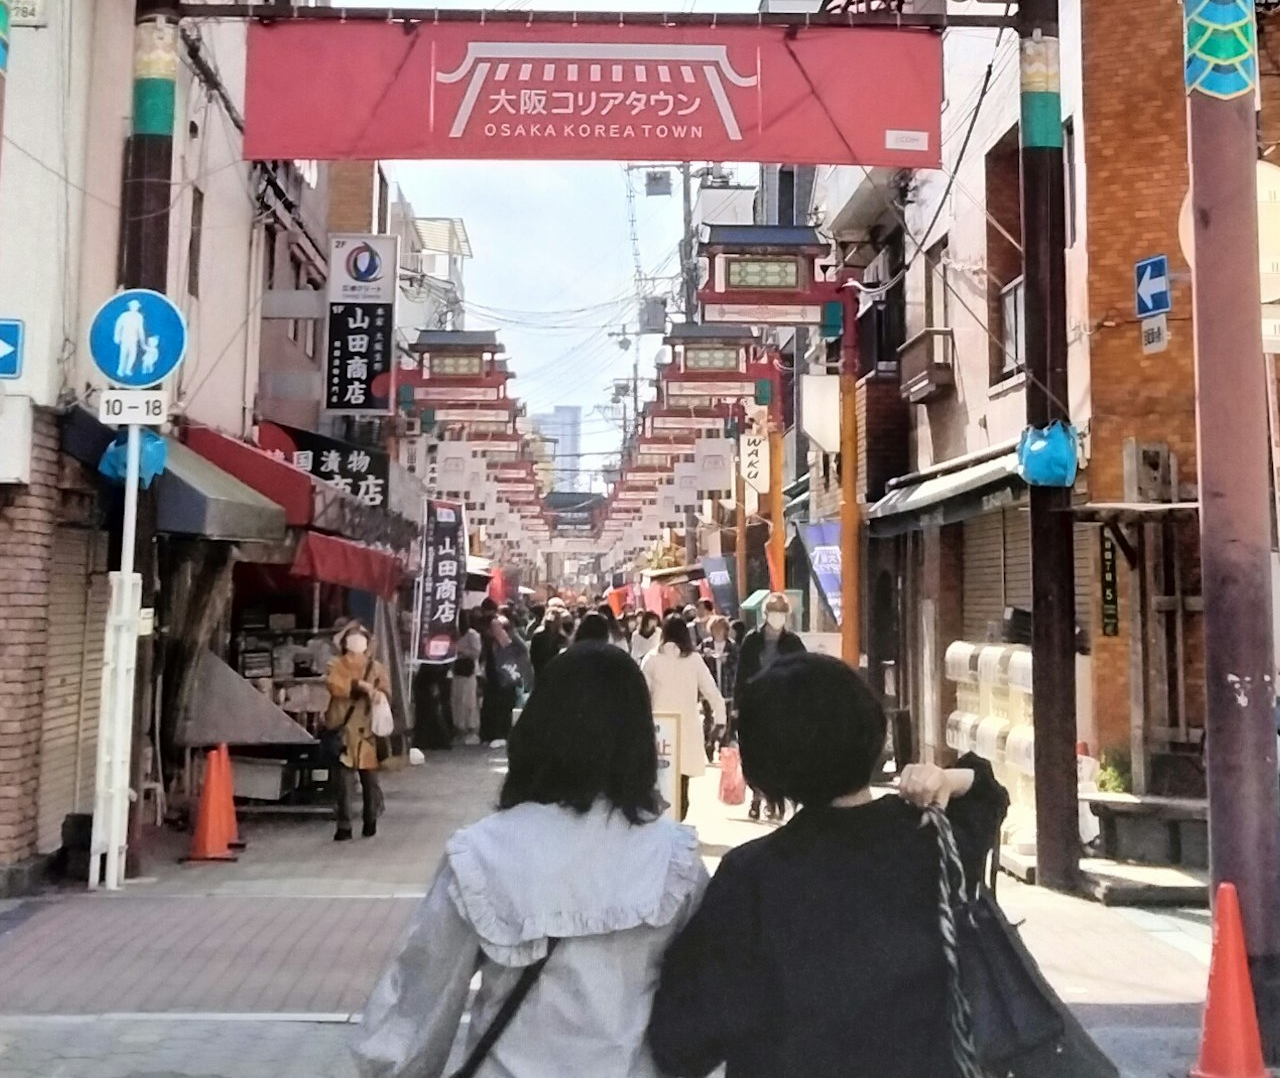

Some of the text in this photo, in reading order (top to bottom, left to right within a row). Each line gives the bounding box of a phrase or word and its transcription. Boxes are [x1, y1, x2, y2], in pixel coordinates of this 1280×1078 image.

[488, 88, 703, 117] 大阪コリアタウン
[483, 122, 705, 140] OSAKA KOREA TOWN
[344, 306, 370, 405] 山田商店
[746, 437, 762, 480] WAKU
[432, 537, 458, 623] 山田商店
